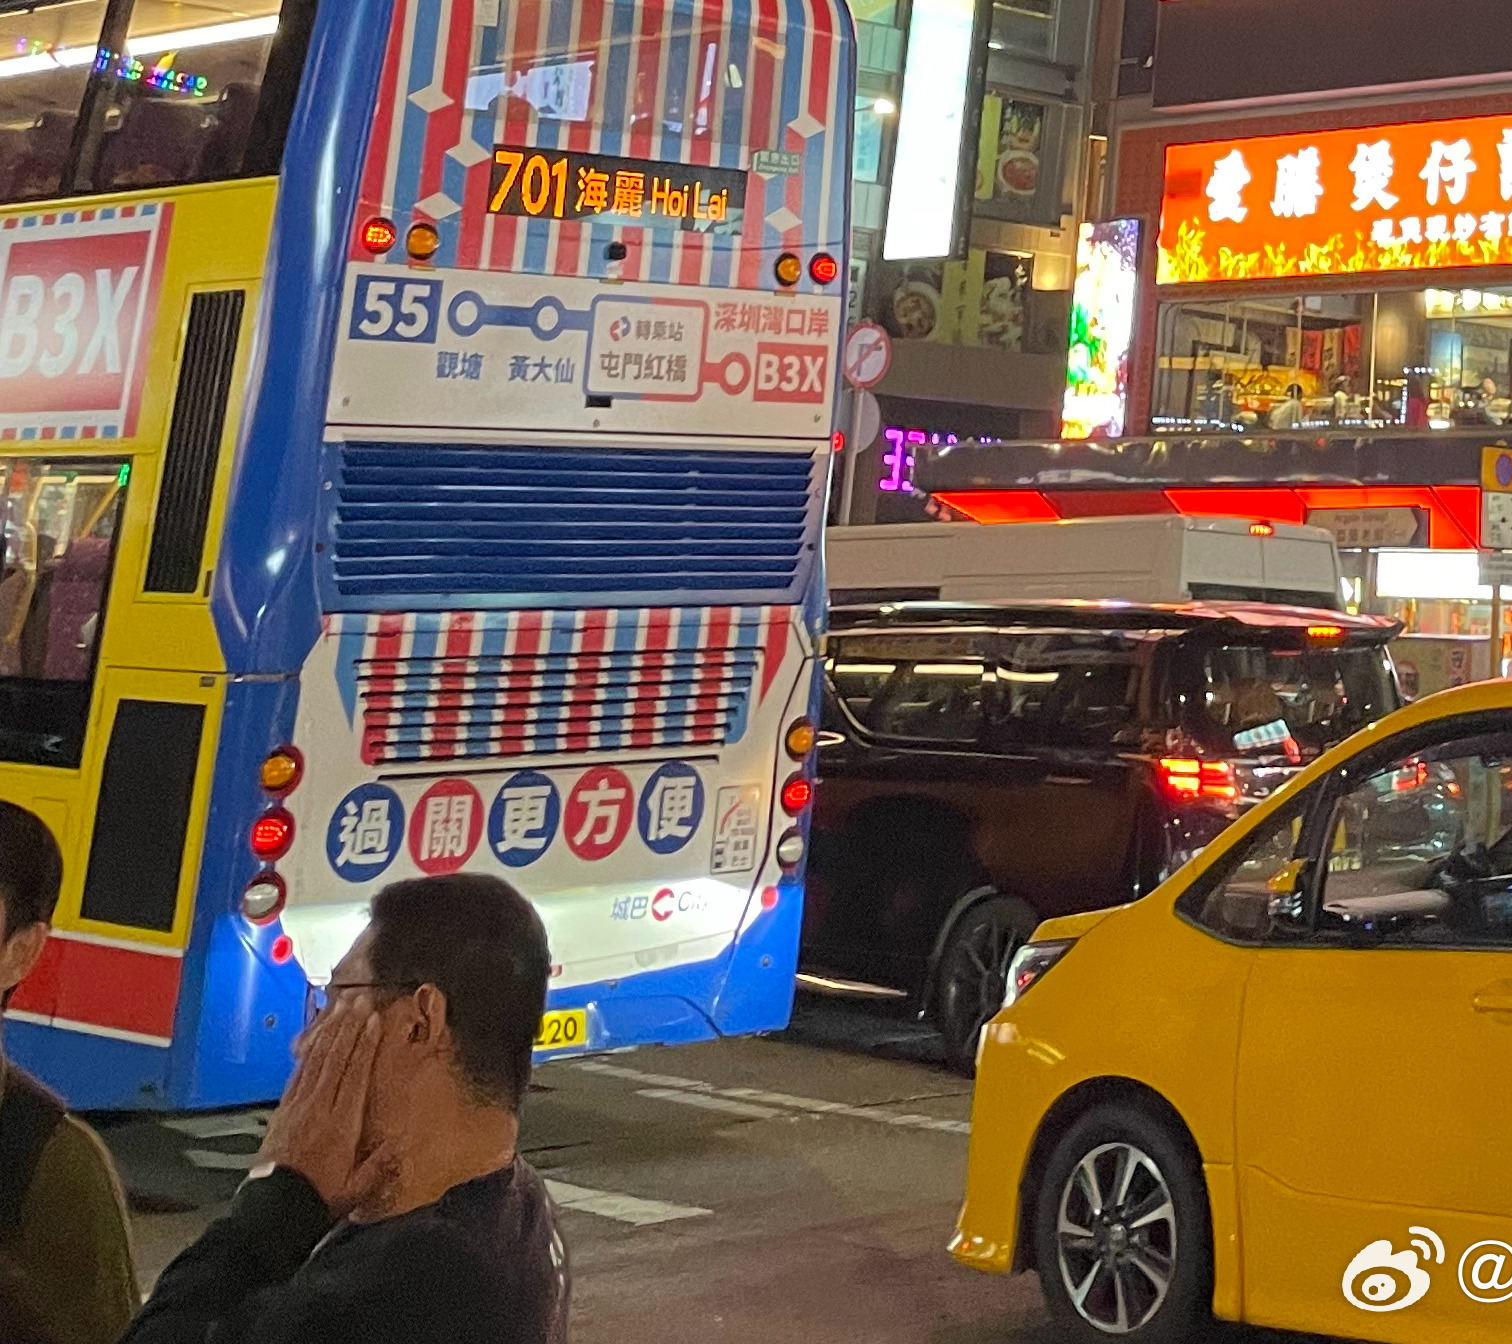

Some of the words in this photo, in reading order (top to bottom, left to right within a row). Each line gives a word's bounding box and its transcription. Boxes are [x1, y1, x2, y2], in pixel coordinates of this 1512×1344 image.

[489, 150, 569, 218] 701
[575, 167, 645, 216] 海麗
[651, 177, 689, 218] Hoi
[694, 181, 728, 222] Lai
[0, 265, 140, 379] B3X
[357, 281, 430, 338] 55
[713, 302, 830, 339] 深圳灣口岸
[435, 350, 485, 381] 觀塘
[507, 355, 576, 385] 黃大仙
[599, 350, 688, 385] 屯門紅橋
[757, 354, 826, 393] B3X
[334, 775, 697, 869] 過關更方便
[610, 895, 649, 920] 城巴
